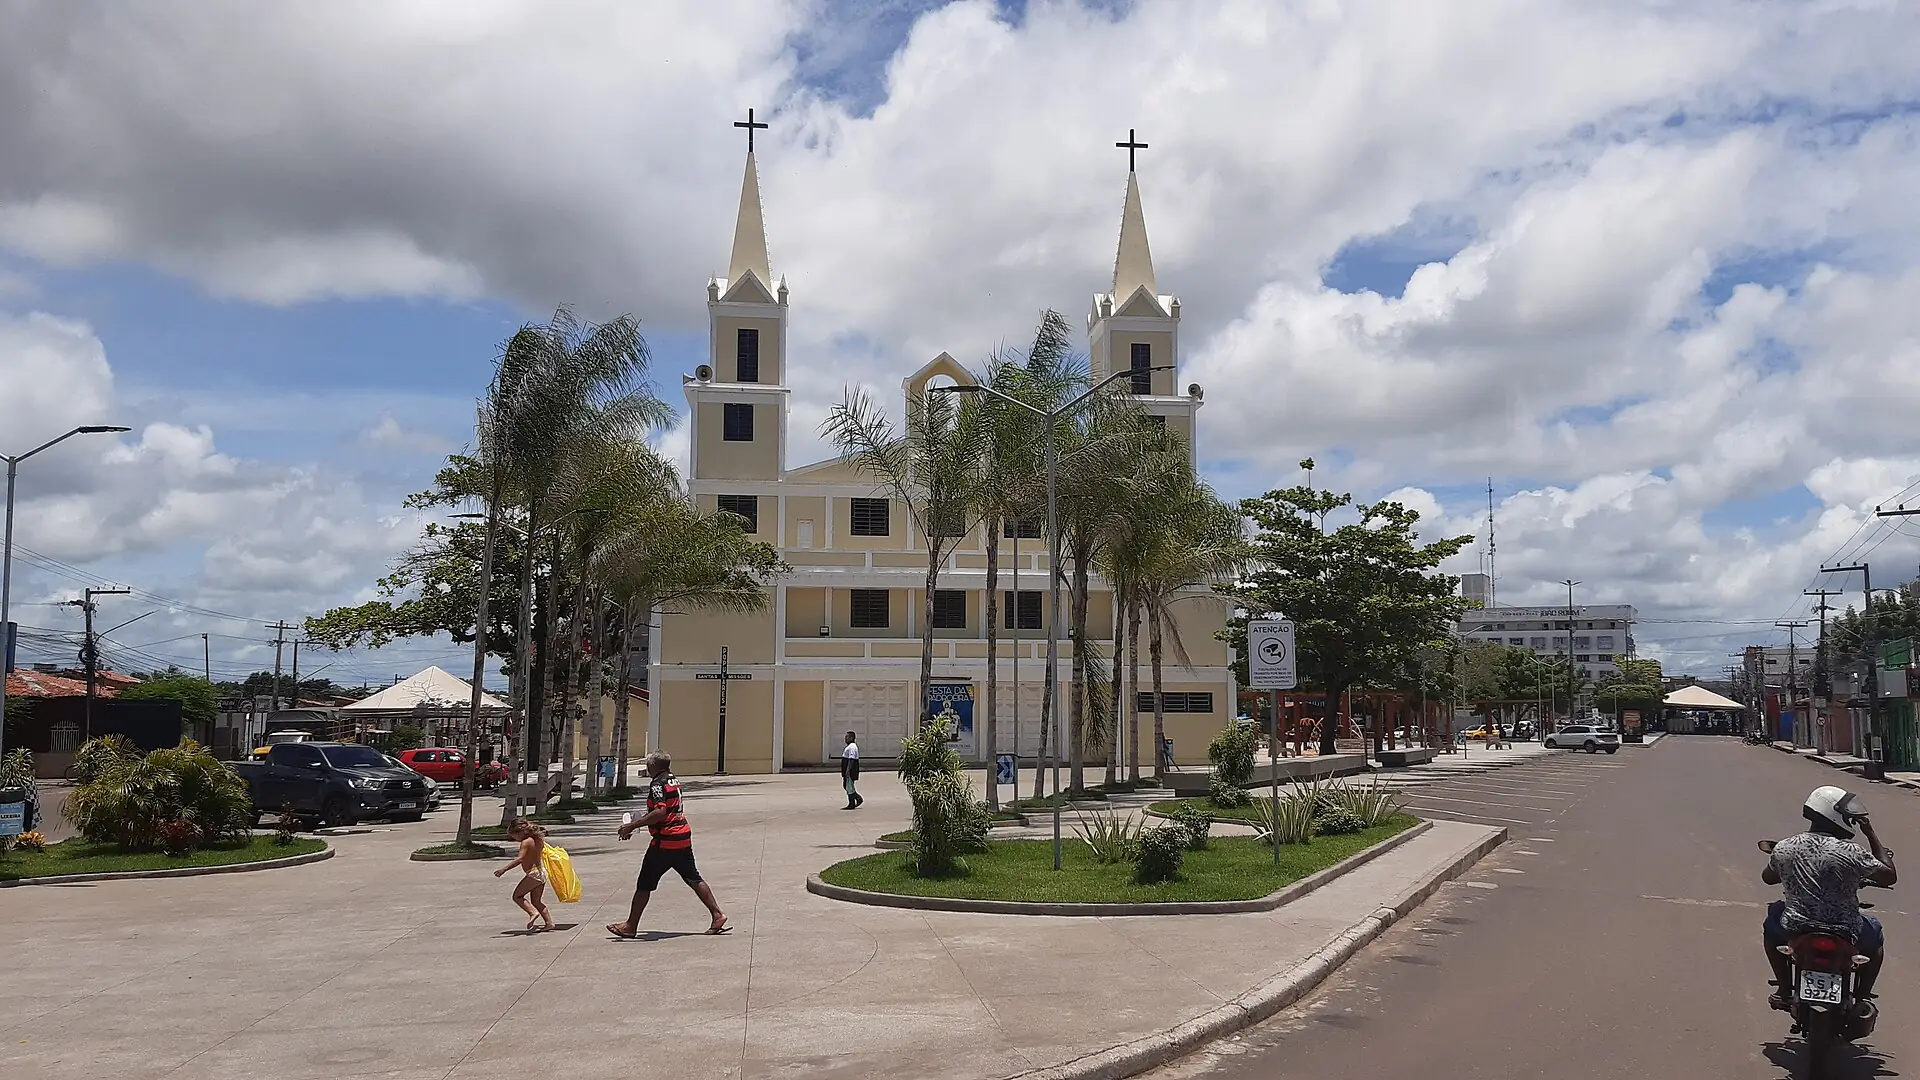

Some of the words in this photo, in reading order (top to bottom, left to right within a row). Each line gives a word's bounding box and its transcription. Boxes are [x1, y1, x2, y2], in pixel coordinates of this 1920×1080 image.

[1253, 625, 1289, 633] ATENÇÃO
[954, 686, 967, 694] DA
[1804, 989, 1837, 1001] 9276
